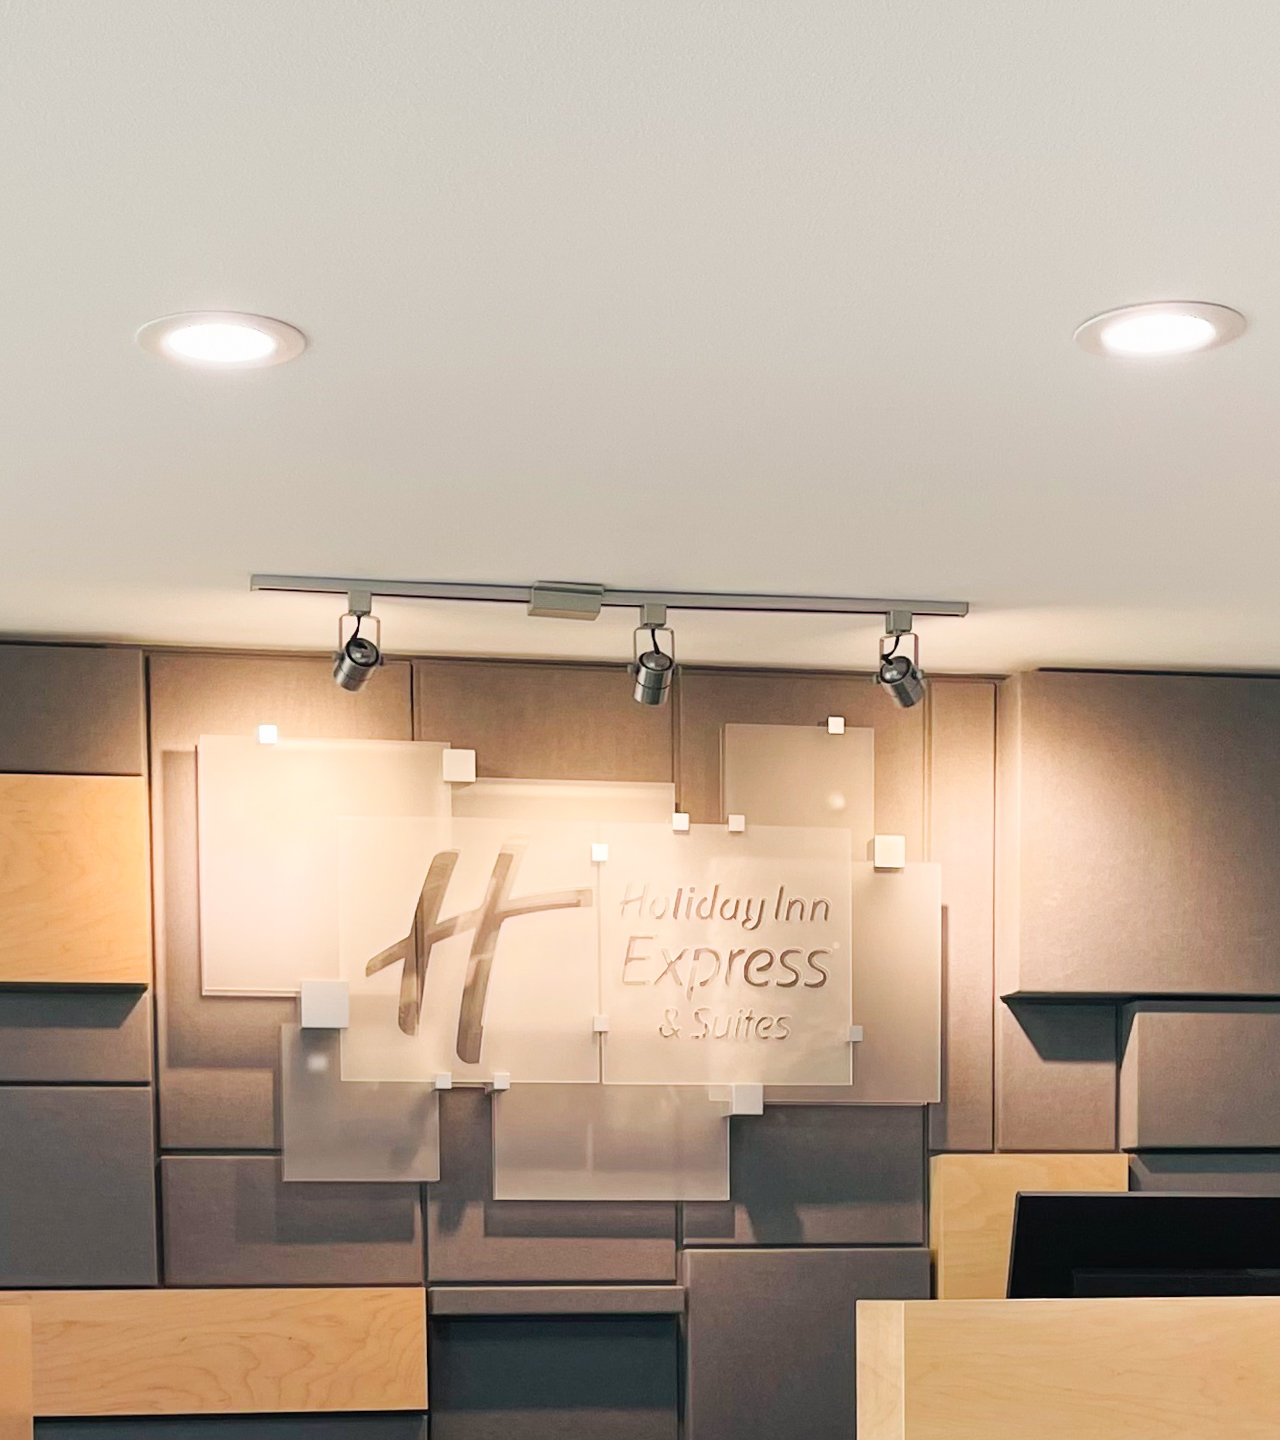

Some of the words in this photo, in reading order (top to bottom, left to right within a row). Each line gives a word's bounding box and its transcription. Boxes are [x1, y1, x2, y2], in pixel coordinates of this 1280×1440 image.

[619, 882, 770, 931] Holiday
[773, 884, 831, 923] Inn
[621, 933, 833, 1001] Express
[658, 1008, 682, 1040] &
[689, 1006, 793, 1041] Suites
